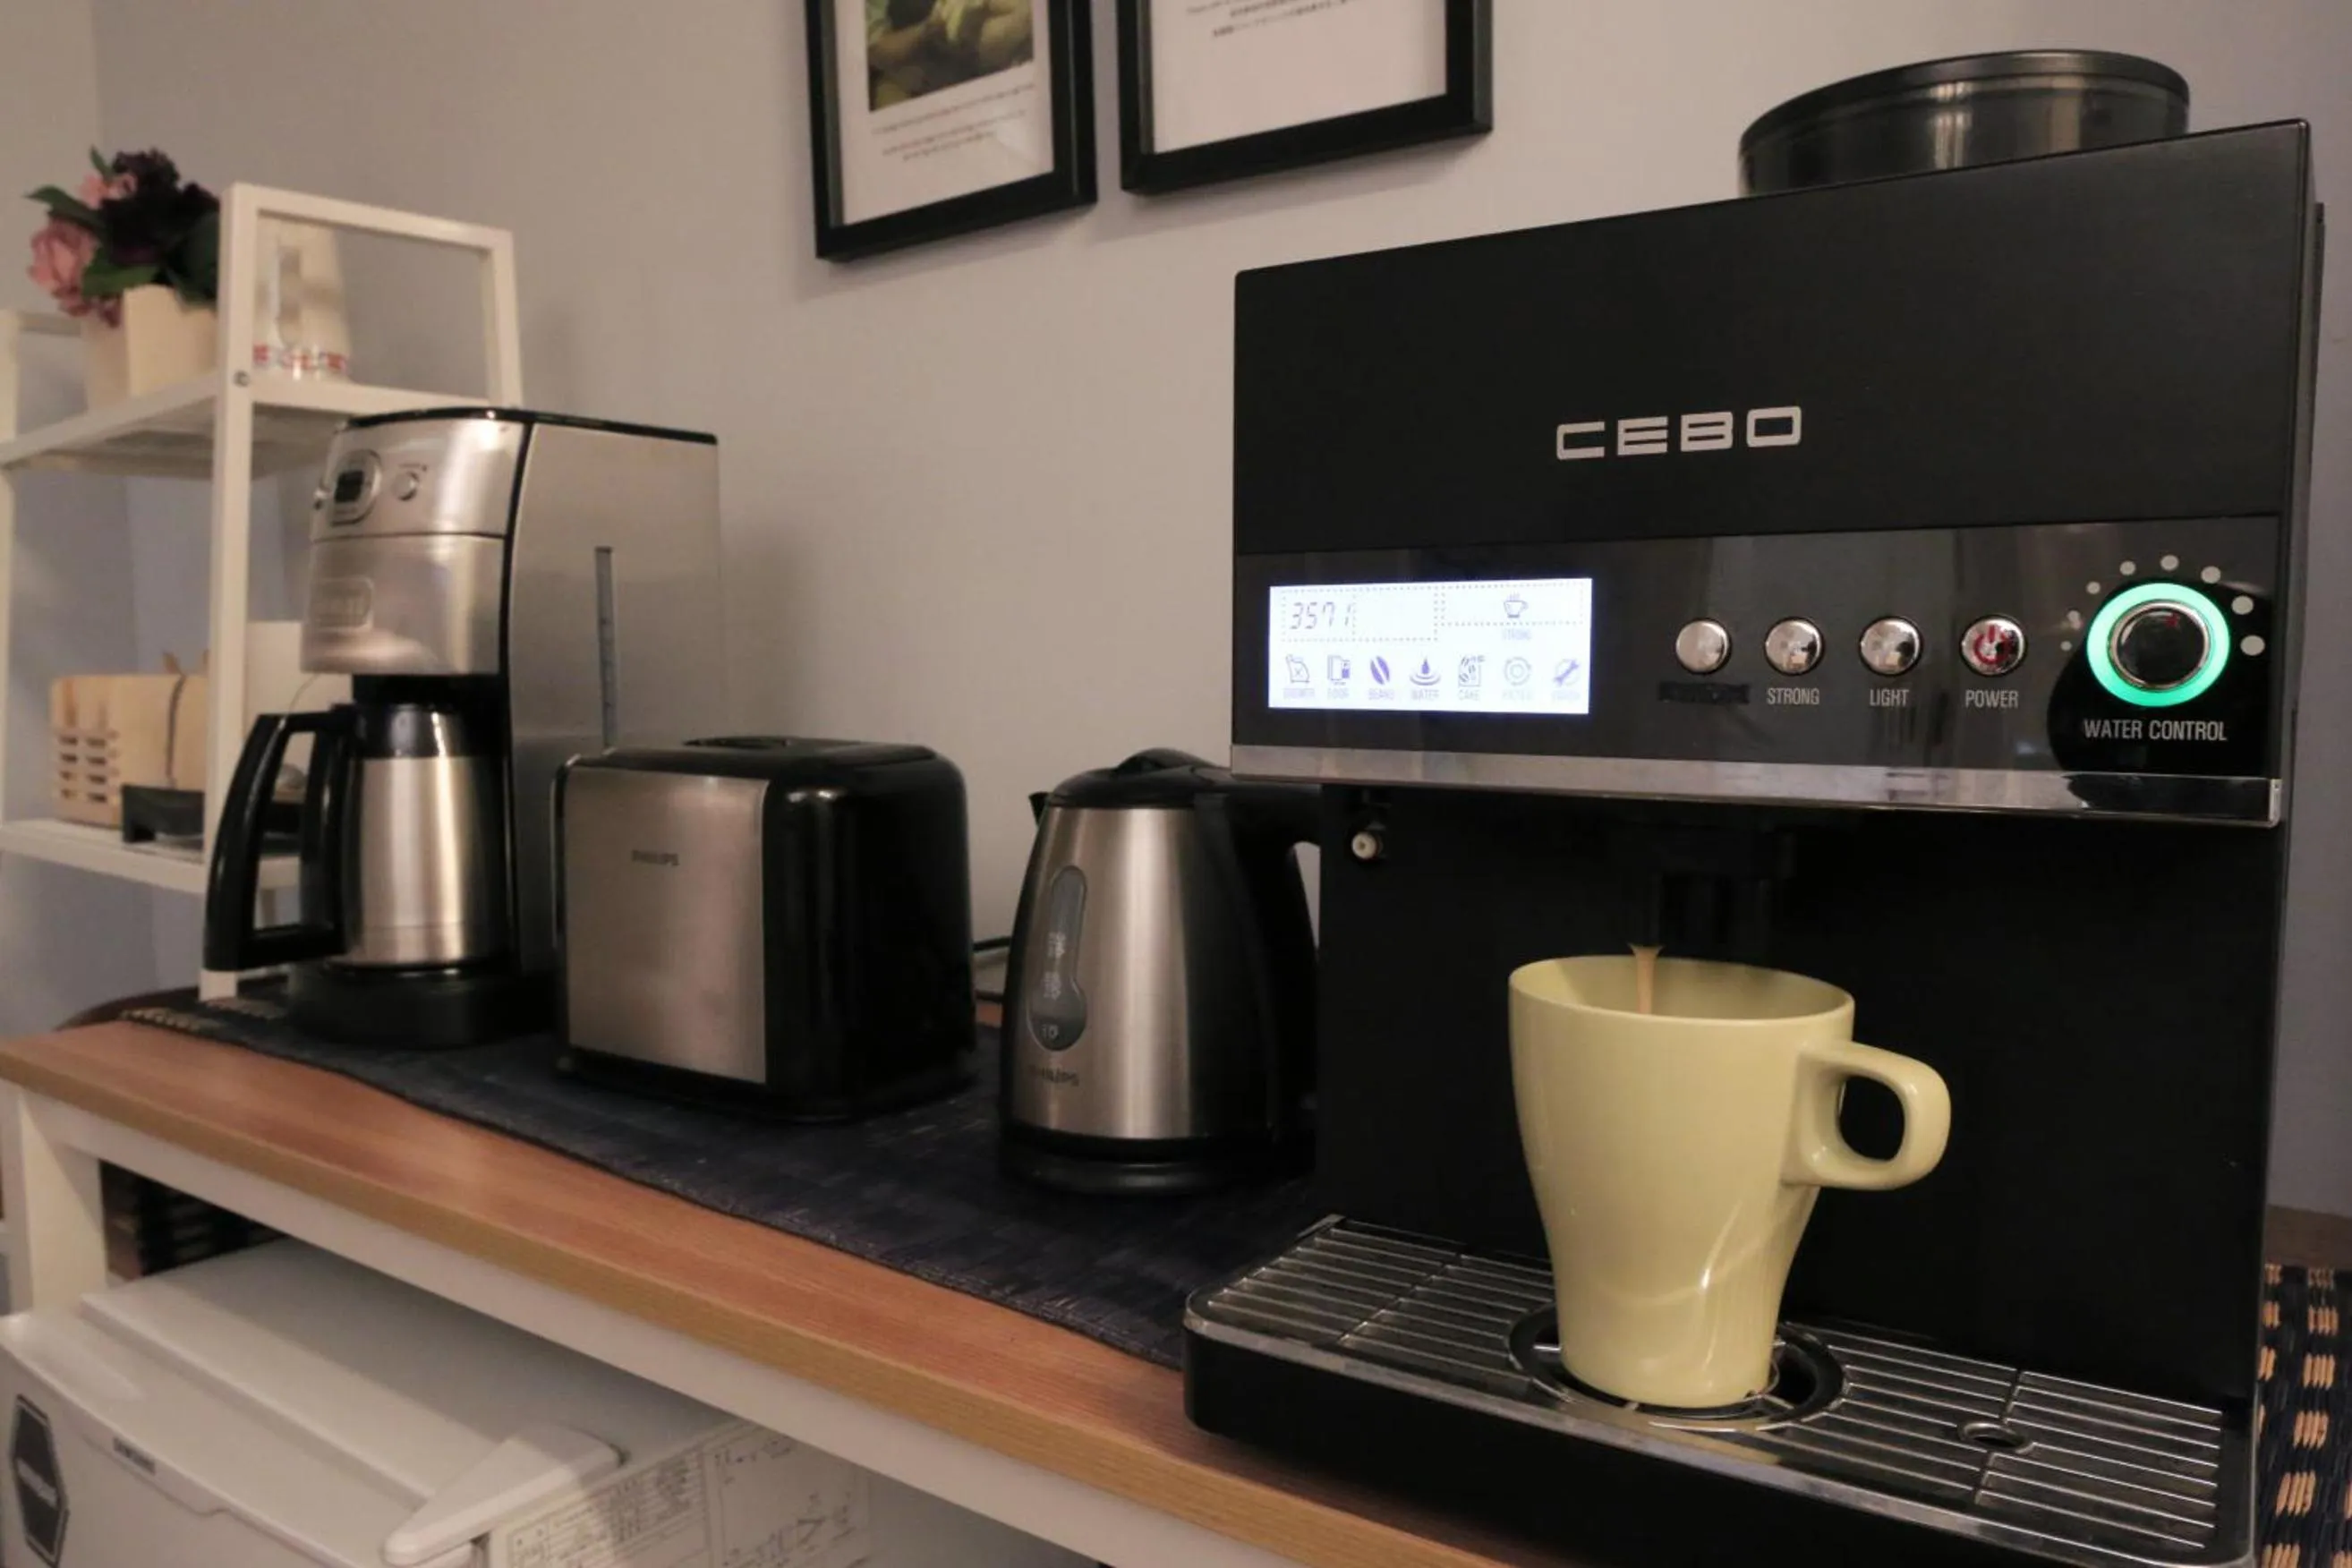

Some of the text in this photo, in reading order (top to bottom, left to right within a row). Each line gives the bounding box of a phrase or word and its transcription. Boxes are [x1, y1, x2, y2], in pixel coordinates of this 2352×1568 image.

[1556, 405, 1802, 460] CEBO
[1766, 687, 1819, 705] STRONG
[1869, 688, 1909, 707] LIGHT
[1964, 689, 2019, 708] POWER
[2083, 719, 2228, 741] WATER CONTROL
